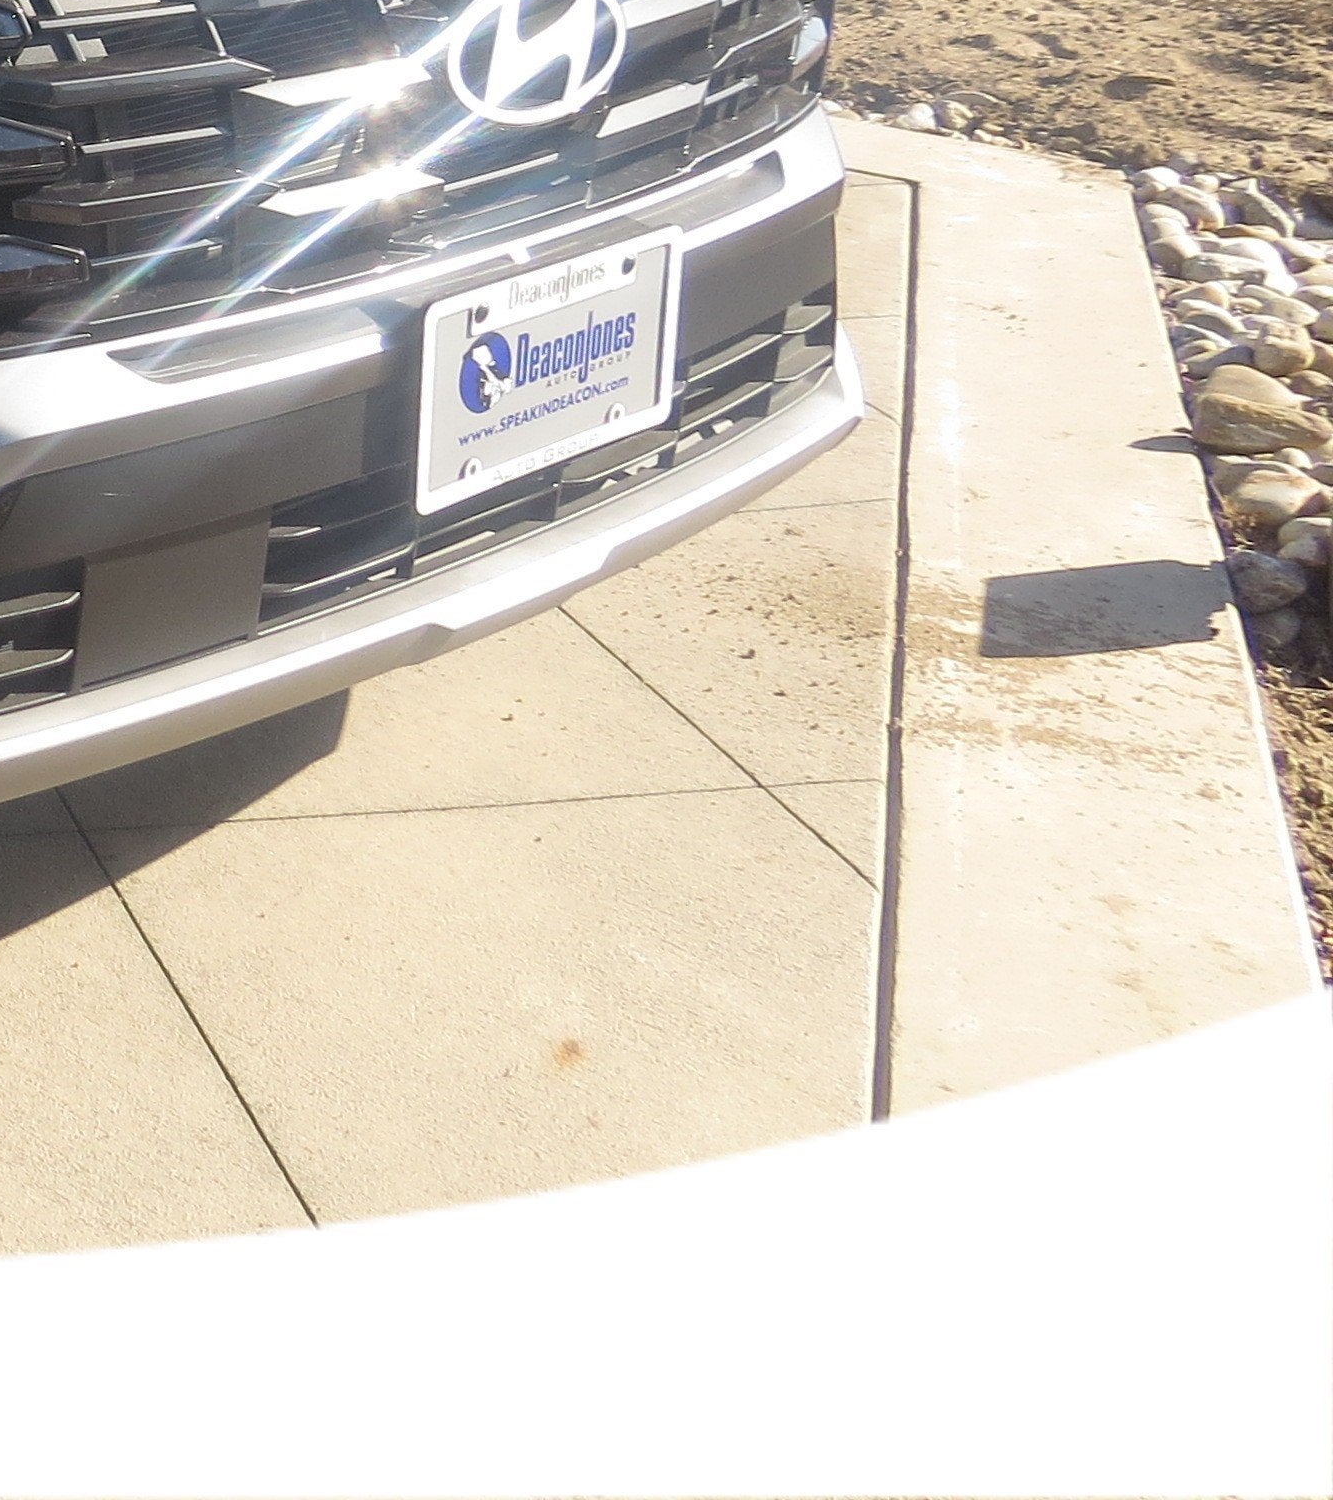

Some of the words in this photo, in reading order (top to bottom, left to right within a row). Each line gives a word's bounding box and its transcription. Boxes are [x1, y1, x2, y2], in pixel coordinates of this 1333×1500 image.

[509, 263, 606, 309] DeaconJones
[515, 311, 636, 388] DeaconJones
[546, 369, 579, 387] AUTO
[589, 350, 632, 375] GROUP
[458, 376, 629, 447] www.SPEAKINDEACON.com
